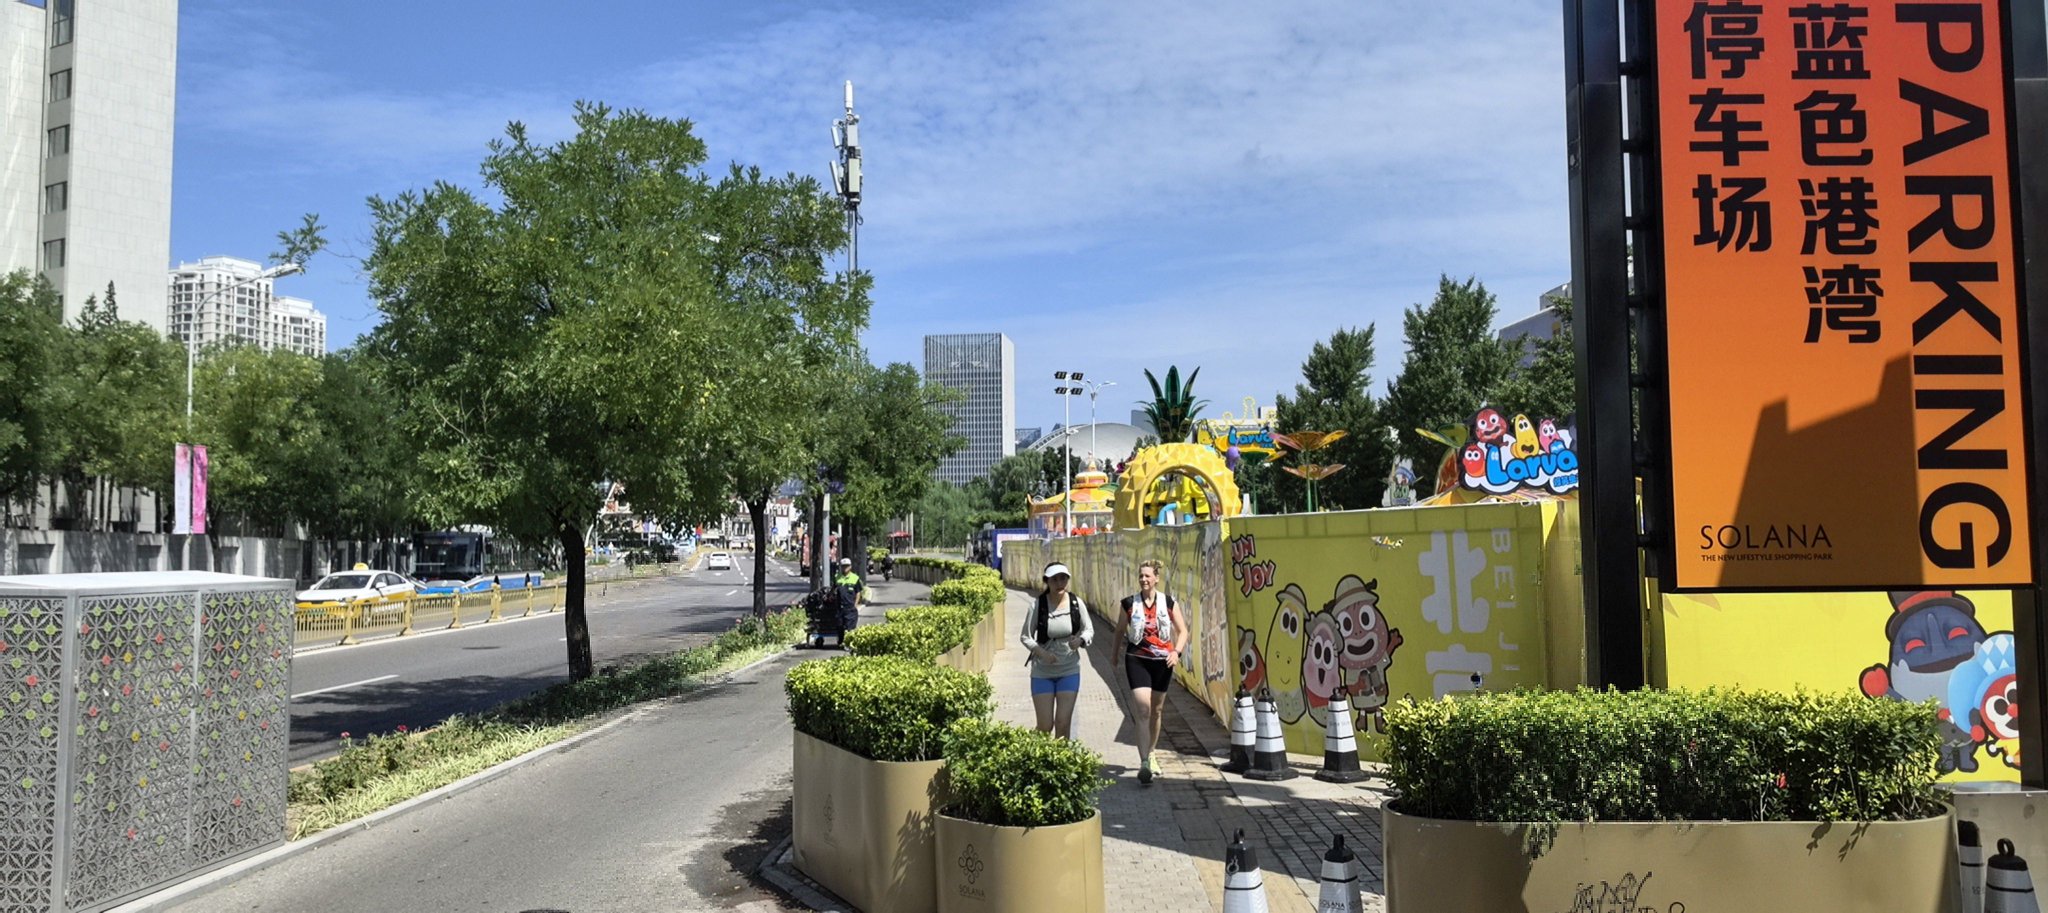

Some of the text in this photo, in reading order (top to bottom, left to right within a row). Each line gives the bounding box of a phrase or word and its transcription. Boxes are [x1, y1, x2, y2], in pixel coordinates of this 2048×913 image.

[1684, 0, 1771, 253] 停车场
[1789, 3, 1884, 344] 蓝色港湾
[1895, 3, 2012, 569] PARKING
[1229, 425, 1274, 446] Larva
[1486, 440, 1578, 486] Larva
[1701, 524, 1832, 550] SOLANA
[1718, 554, 1736, 562] NEW
[1774, 553, 1812, 561] SHOPPING
[1241, 559, 1277, 598] JOY
